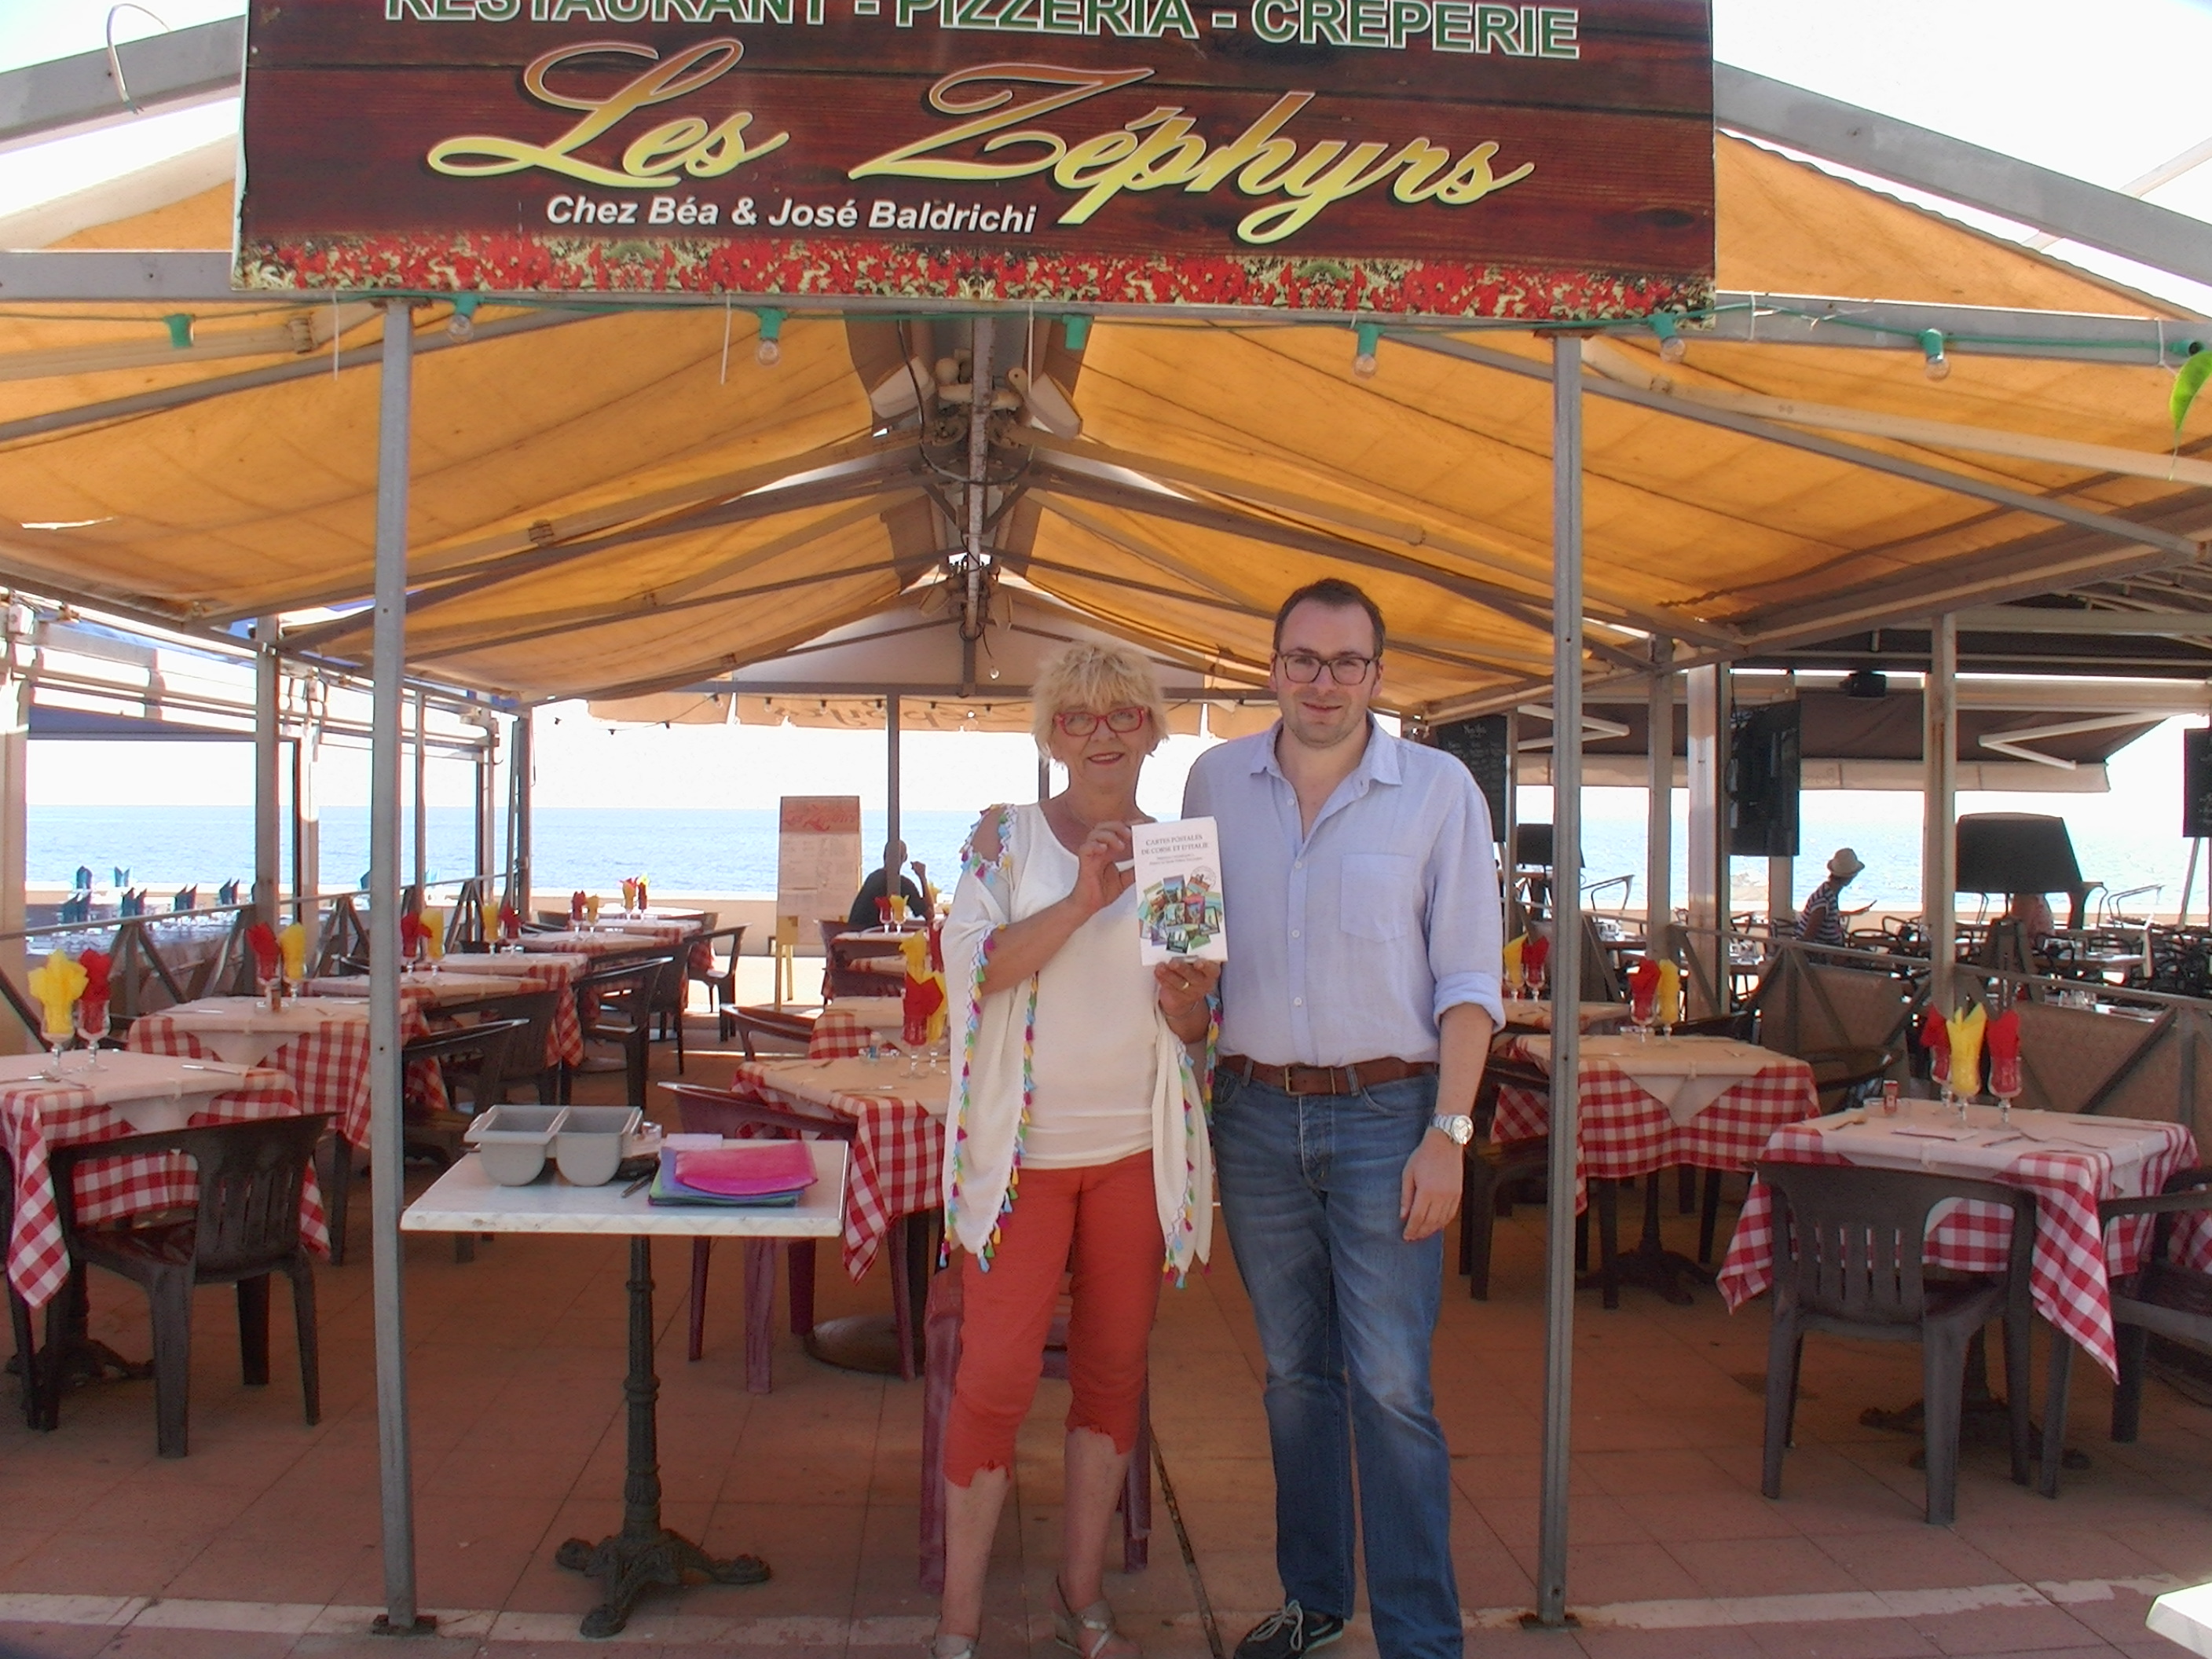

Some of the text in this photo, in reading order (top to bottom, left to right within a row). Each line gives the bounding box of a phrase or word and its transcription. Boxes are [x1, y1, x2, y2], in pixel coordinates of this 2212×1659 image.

[896, 0, 1200, 38] PIZZERIA
[427, 37, 1535, 245] Les Zéphyrs
[548, 195, 1038, 233] Chez Béa & José Baldrichi
